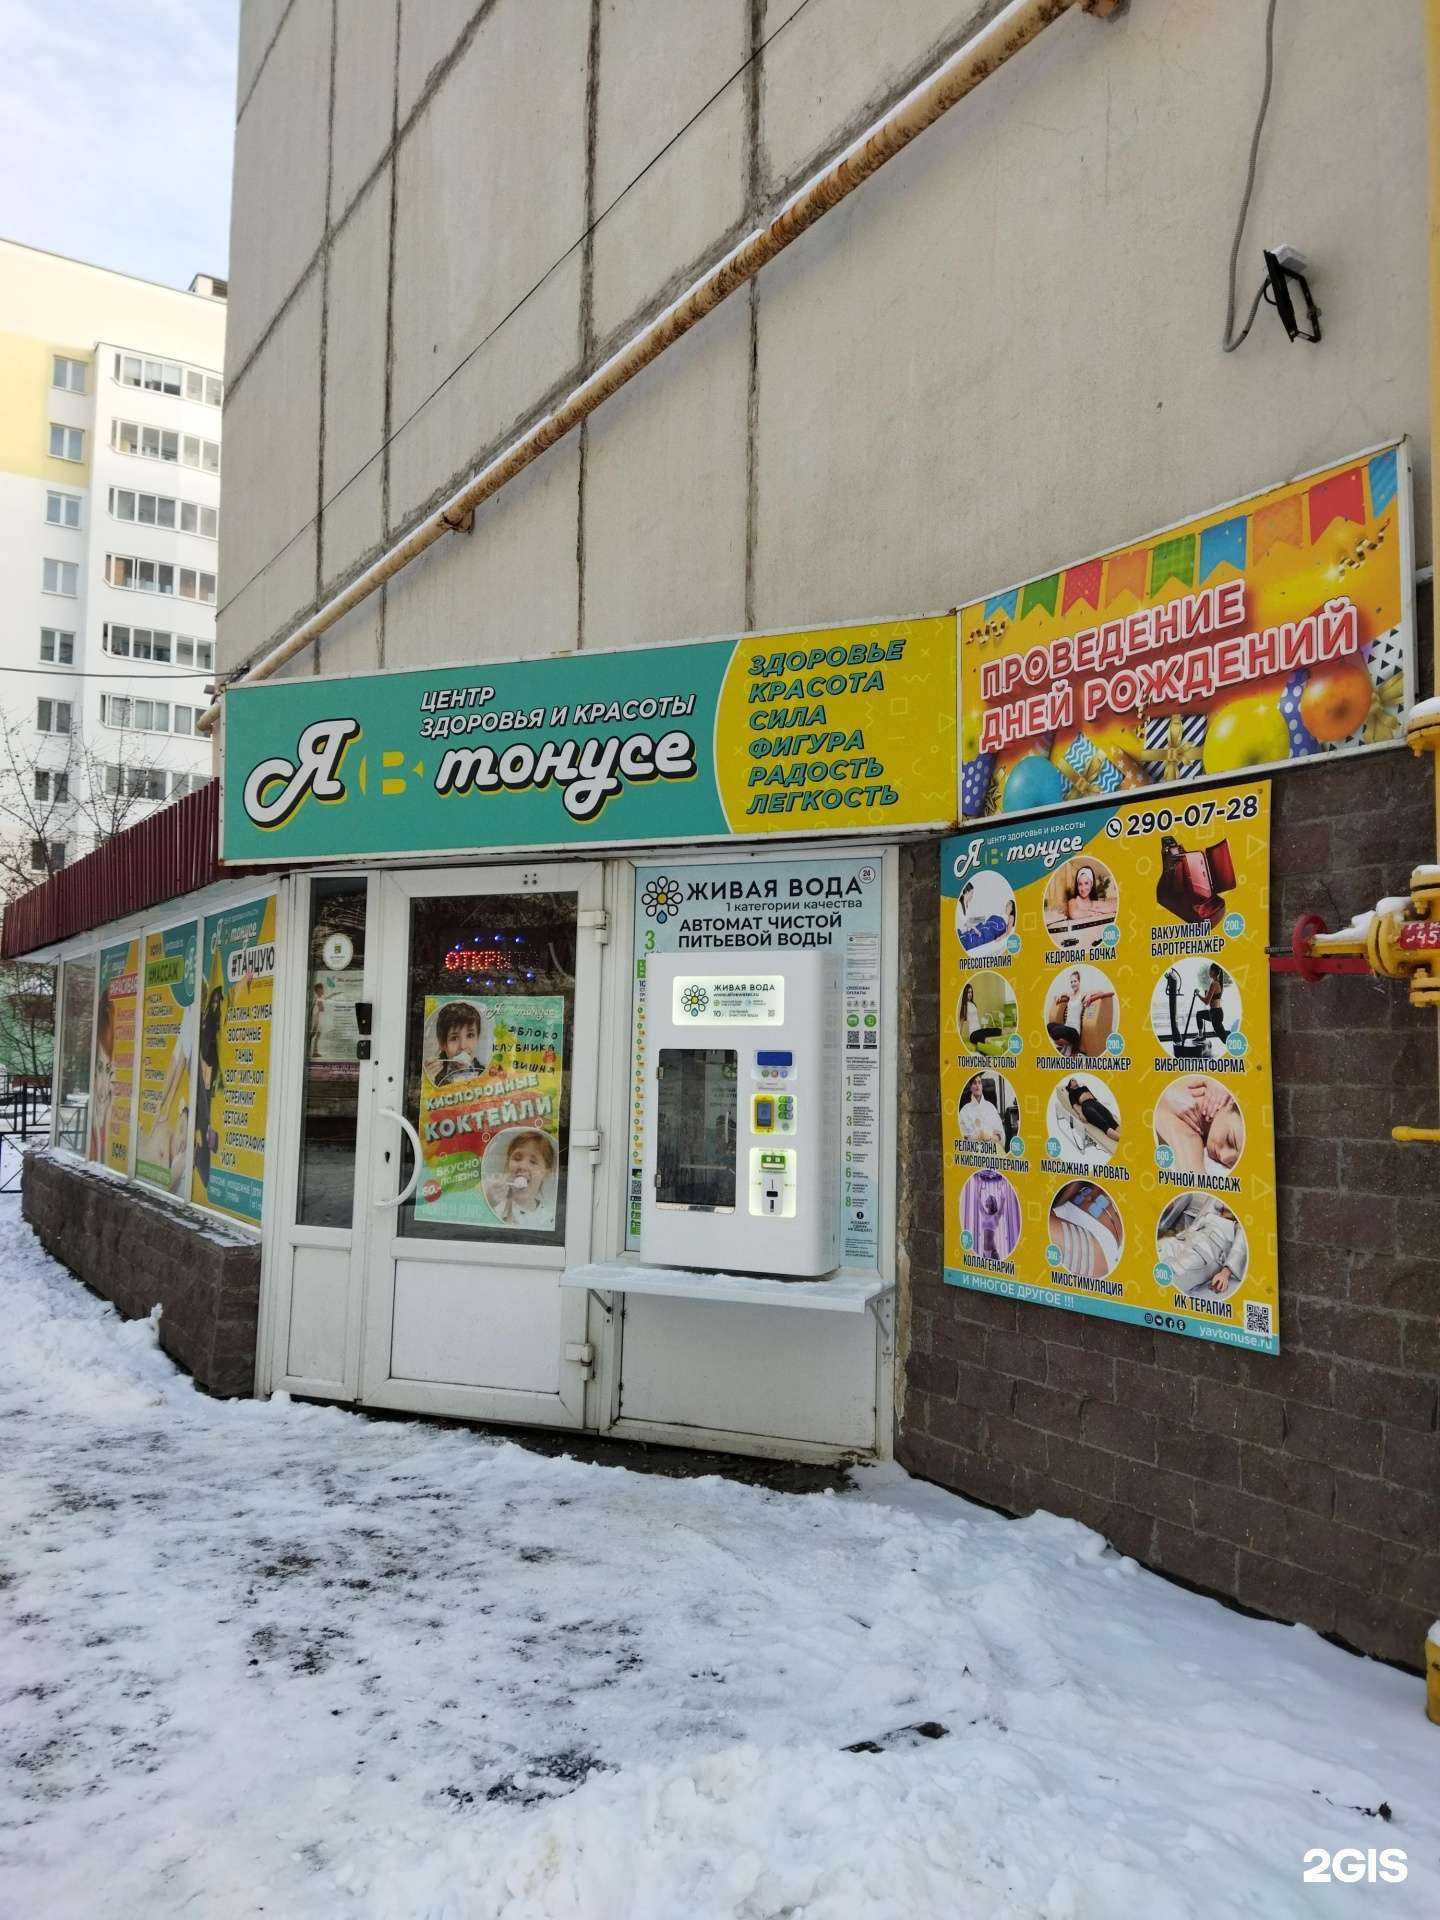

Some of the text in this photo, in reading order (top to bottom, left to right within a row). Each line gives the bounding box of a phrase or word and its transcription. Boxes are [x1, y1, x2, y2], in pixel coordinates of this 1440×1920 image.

[979, 578, 1248, 699] ПРОВЕДЕНИЕ
[748, 639, 907, 679] ЗДОРОВЬЕ
[748, 670, 885, 703] КРАСОТА
[979, 596, 1358, 753] ДНЕЙ РОЖДЕНИЙ
[421, 686, 494, 712] ЦЕНТР
[420, 694, 694, 739] ЗДОРОВЬЯ И КРАСОТЫ
[748, 704, 827, 732] СИЛА
[747, 730, 865, 759] ФИГУРА
[244, 717, 362, 830] Я
[433, 730, 697, 824] тонусе
[747, 757, 884, 787] РАДОСТЬ
[745, 786, 898, 815] ЛЕГКОСТЬ
[1126, 794, 1261, 837] 290-07-28
[987, 820, 1086, 845] ЦЕНТР ЗДОРОВЬЯ И КРАСОТЫ
[954, 838, 985, 879] Я
[1006, 835, 1084, 869] тонусе
[687, 876, 863, 901] ЖИВАЯ ВОДА
[726, 899, 863, 914] 1 категории качества
[680, 911, 842, 932] АВТОМАТ ЧИСТОЙ
[1151, 919, 1210, 940] ВАКУУМНЫЙ
[645, 930, 656, 950] 3
[679, 930, 832, 949] ПИТЬЕВОЙ ВОДЫ
[1151, 936, 1226, 957] БАРОТРЕНАЖЁР
[231, 946, 275, 977] #ТАНЦУЮ
[960, 955, 1011, 970] ПРЕССОТЕРАПИЯ
[1045, 946, 1116, 965] КЕДРОВАЯ БОЧКА
[713, 983, 776, 992] ЖИВАЯ ВОДА
[492, 1043, 556, 1052] КЛУБНИКА
[512, 1060, 556, 1074] ВИШНЯ
[957, 1055, 1018, 1069] ТОНУСНЫЕ СТОЛЫ
[1036, 1054, 1132, 1071] РОЛИКОВЫЙ МАССАЖЕР
[1154, 1056, 1246, 1073] ВИБРОПЛАТФОРМА
[426, 1074, 539, 1111] КИСЛОРОДНЫЕ
[425, 1096, 553, 1142] КОКТЕЙЛИ
[954, 1139, 997, 1155] РЕЛАКС ЗОНА
[954, 1153, 1029, 1172] И КИСЛОРОДОТЕРАПИЯ
[1040, 1160, 1130, 1180] МАССАЖНАЯ КРОВАТЬ
[1158, 1169, 1241, 1192] РУЧНОЙ МАССАЖ
[963, 1254, 1015, 1275] КОЛЛАГЕНАРИЙ
[962, 1275, 968, 1286] И
[970, 1277, 1015, 1296] МНОГОЕ
[1017, 1286, 1061, 1305] ДРУГОЕ
[1051, 1271, 1124, 1297] МИОСТИМУЛЯЦИЯ
[1173, 1294, 1233, 1318] ИК ТЕРАПИЯ
[1199, 1323, 1273, 1350] yavtonuse.ru
